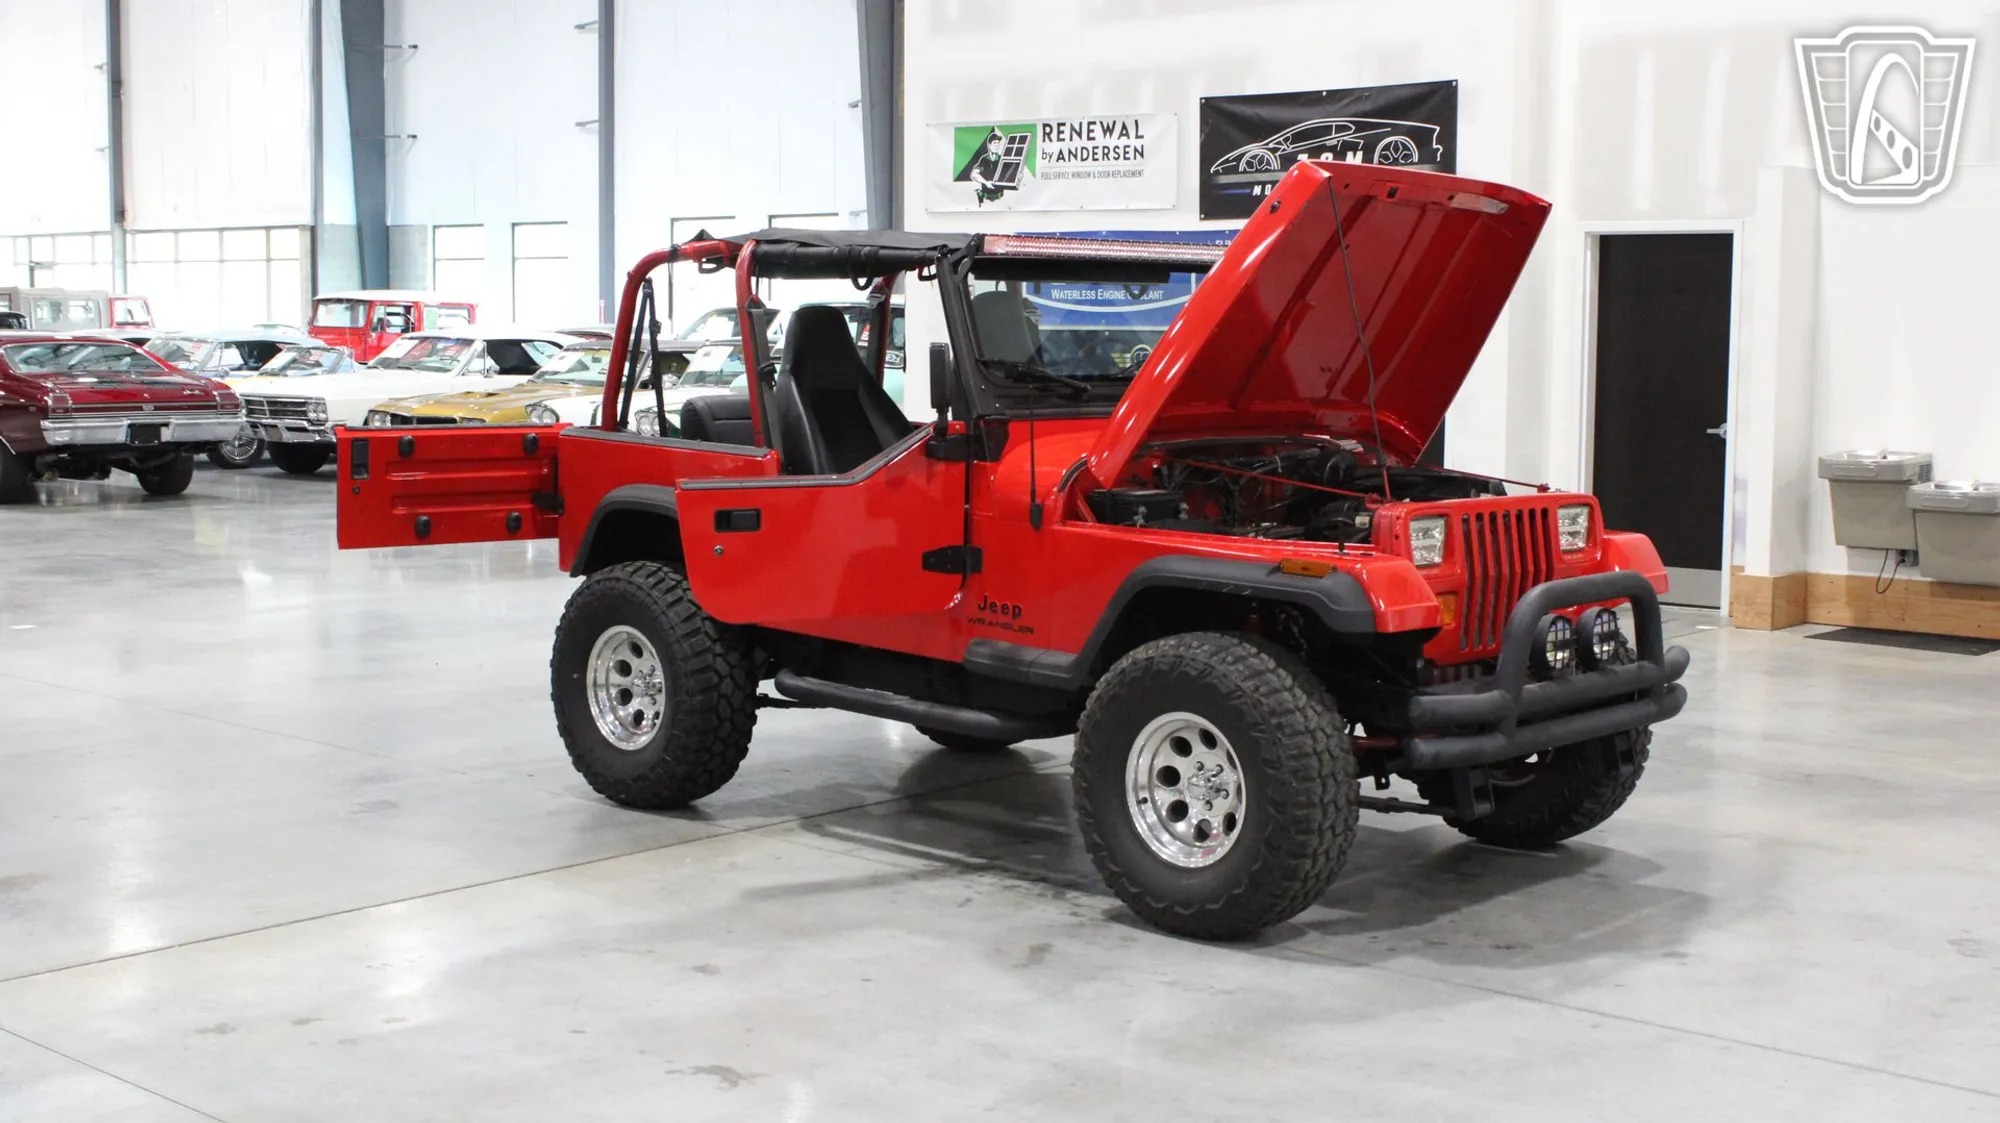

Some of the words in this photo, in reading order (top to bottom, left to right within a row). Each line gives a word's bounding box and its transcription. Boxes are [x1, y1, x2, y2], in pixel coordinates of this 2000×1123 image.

[1042, 119, 1144, 143] RENEWAL
[1041, 149, 1055, 163] by
[1056, 144, 1144, 162] ANDERSEN
[1071, 170, 1091, 180] WINDOW
[1097, 169, 1111, 179] DOOR
[1111, 168, 1144, 179] REPLACEMENT
[1051, 289, 1096, 300] WATERLESS
[1097, 289, 1126, 300] ENGINE
[977, 594, 1022, 620] Jeep
[966, 616, 1035, 635] WRANGLER
